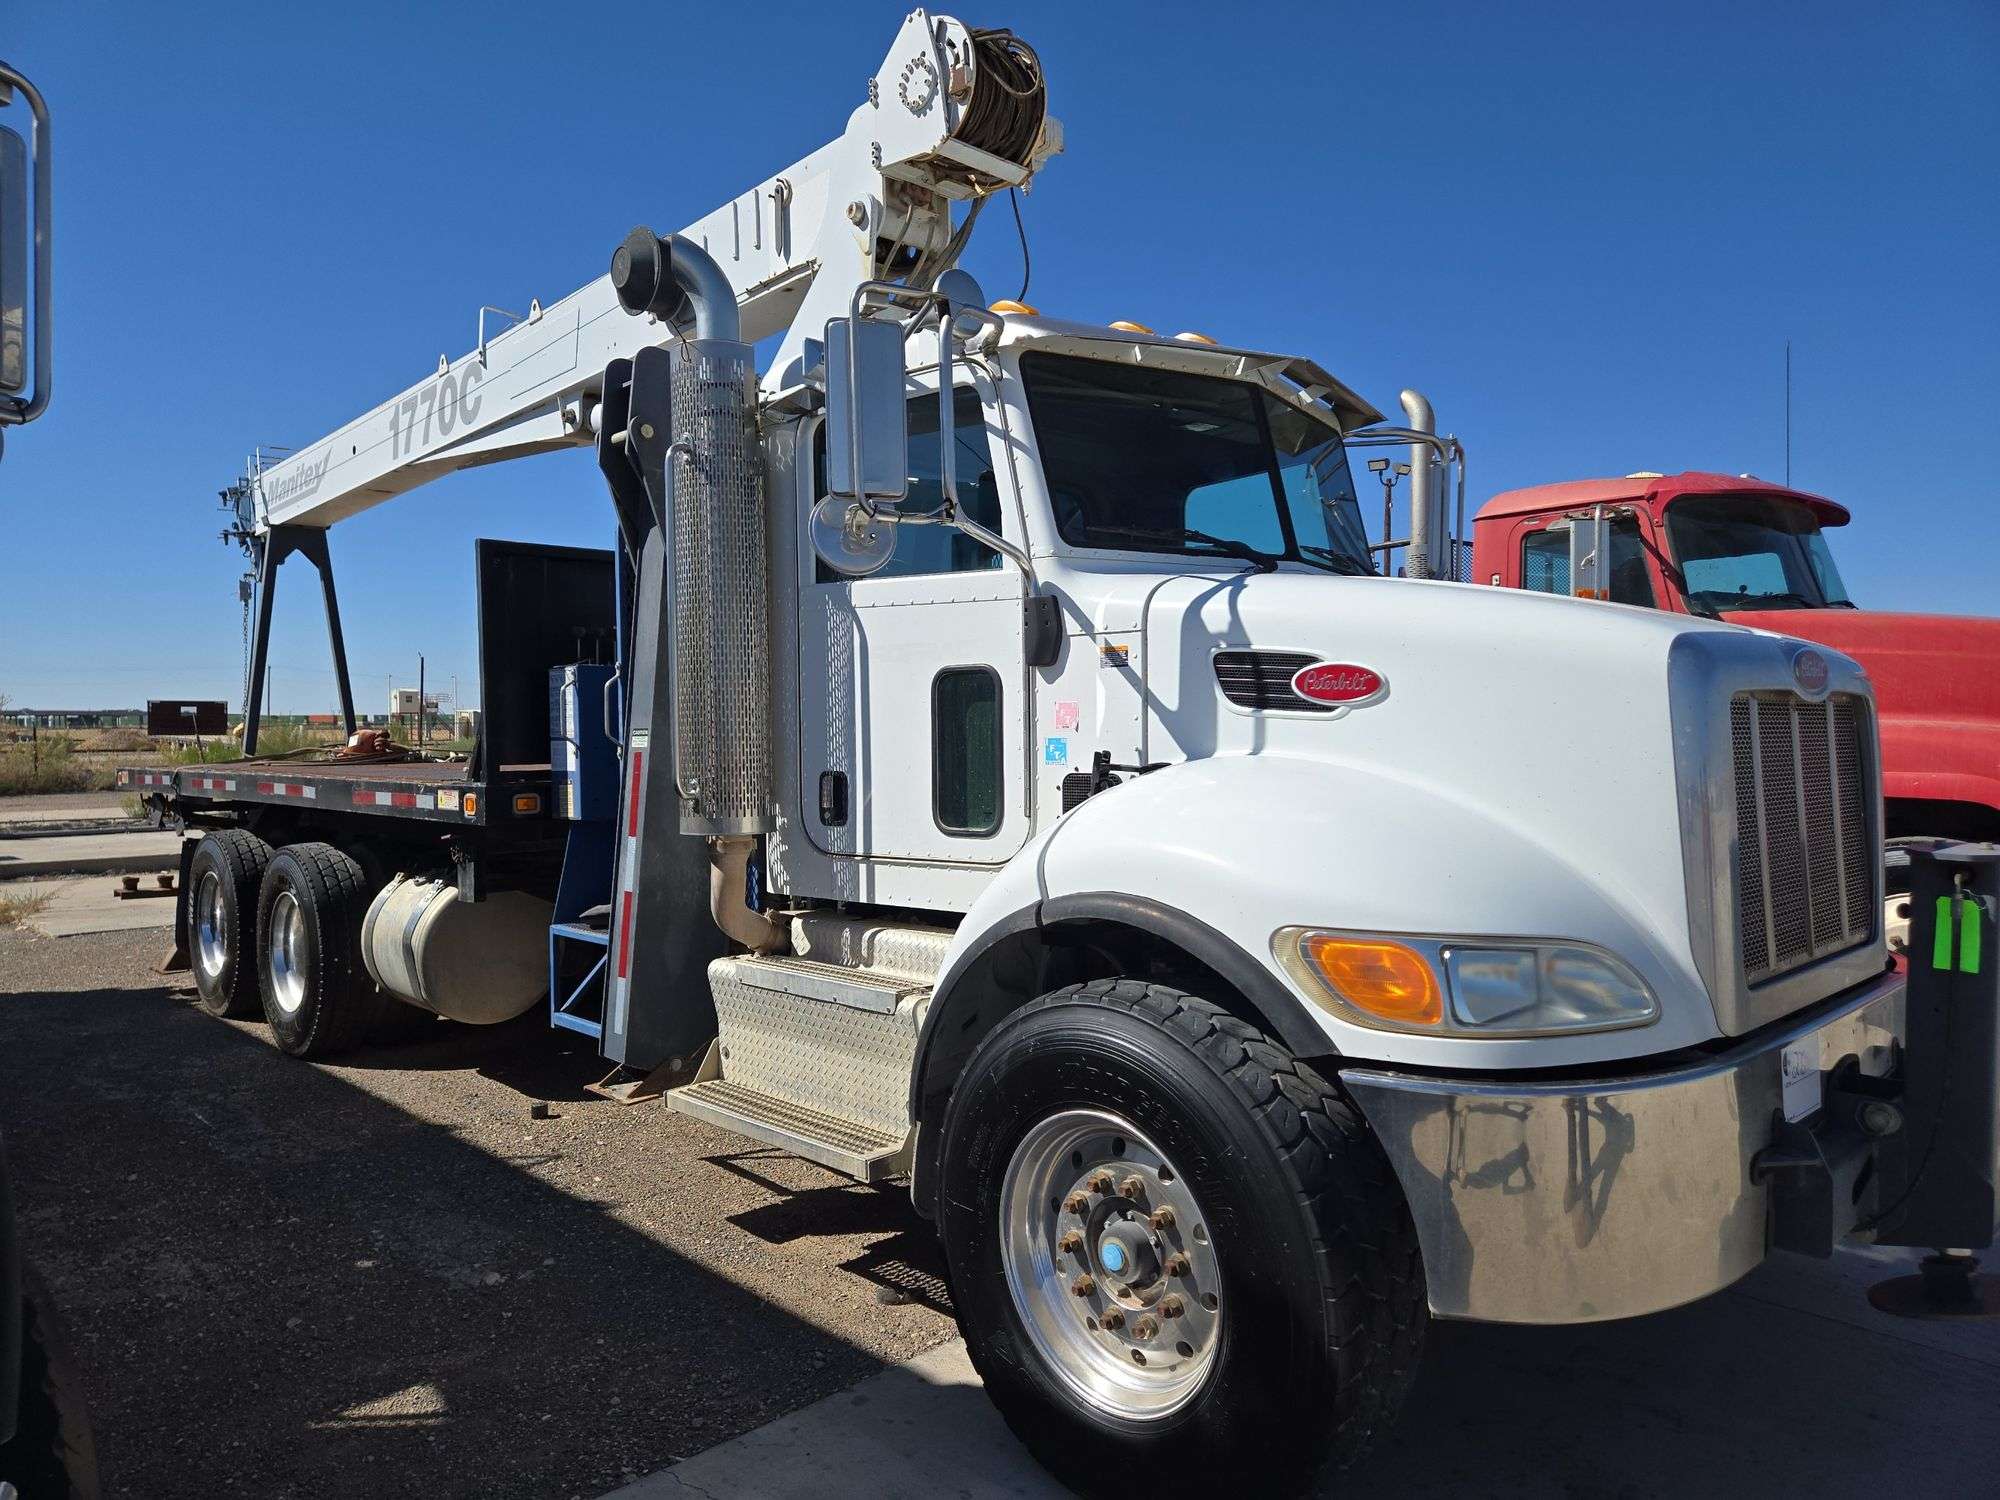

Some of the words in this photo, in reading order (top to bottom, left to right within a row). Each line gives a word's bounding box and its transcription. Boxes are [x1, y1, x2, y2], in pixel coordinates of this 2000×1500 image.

[389, 361, 482, 460] 1770C
[267, 448, 331, 507] Manitex
[1303, 670, 1373, 691] Peterbilt
